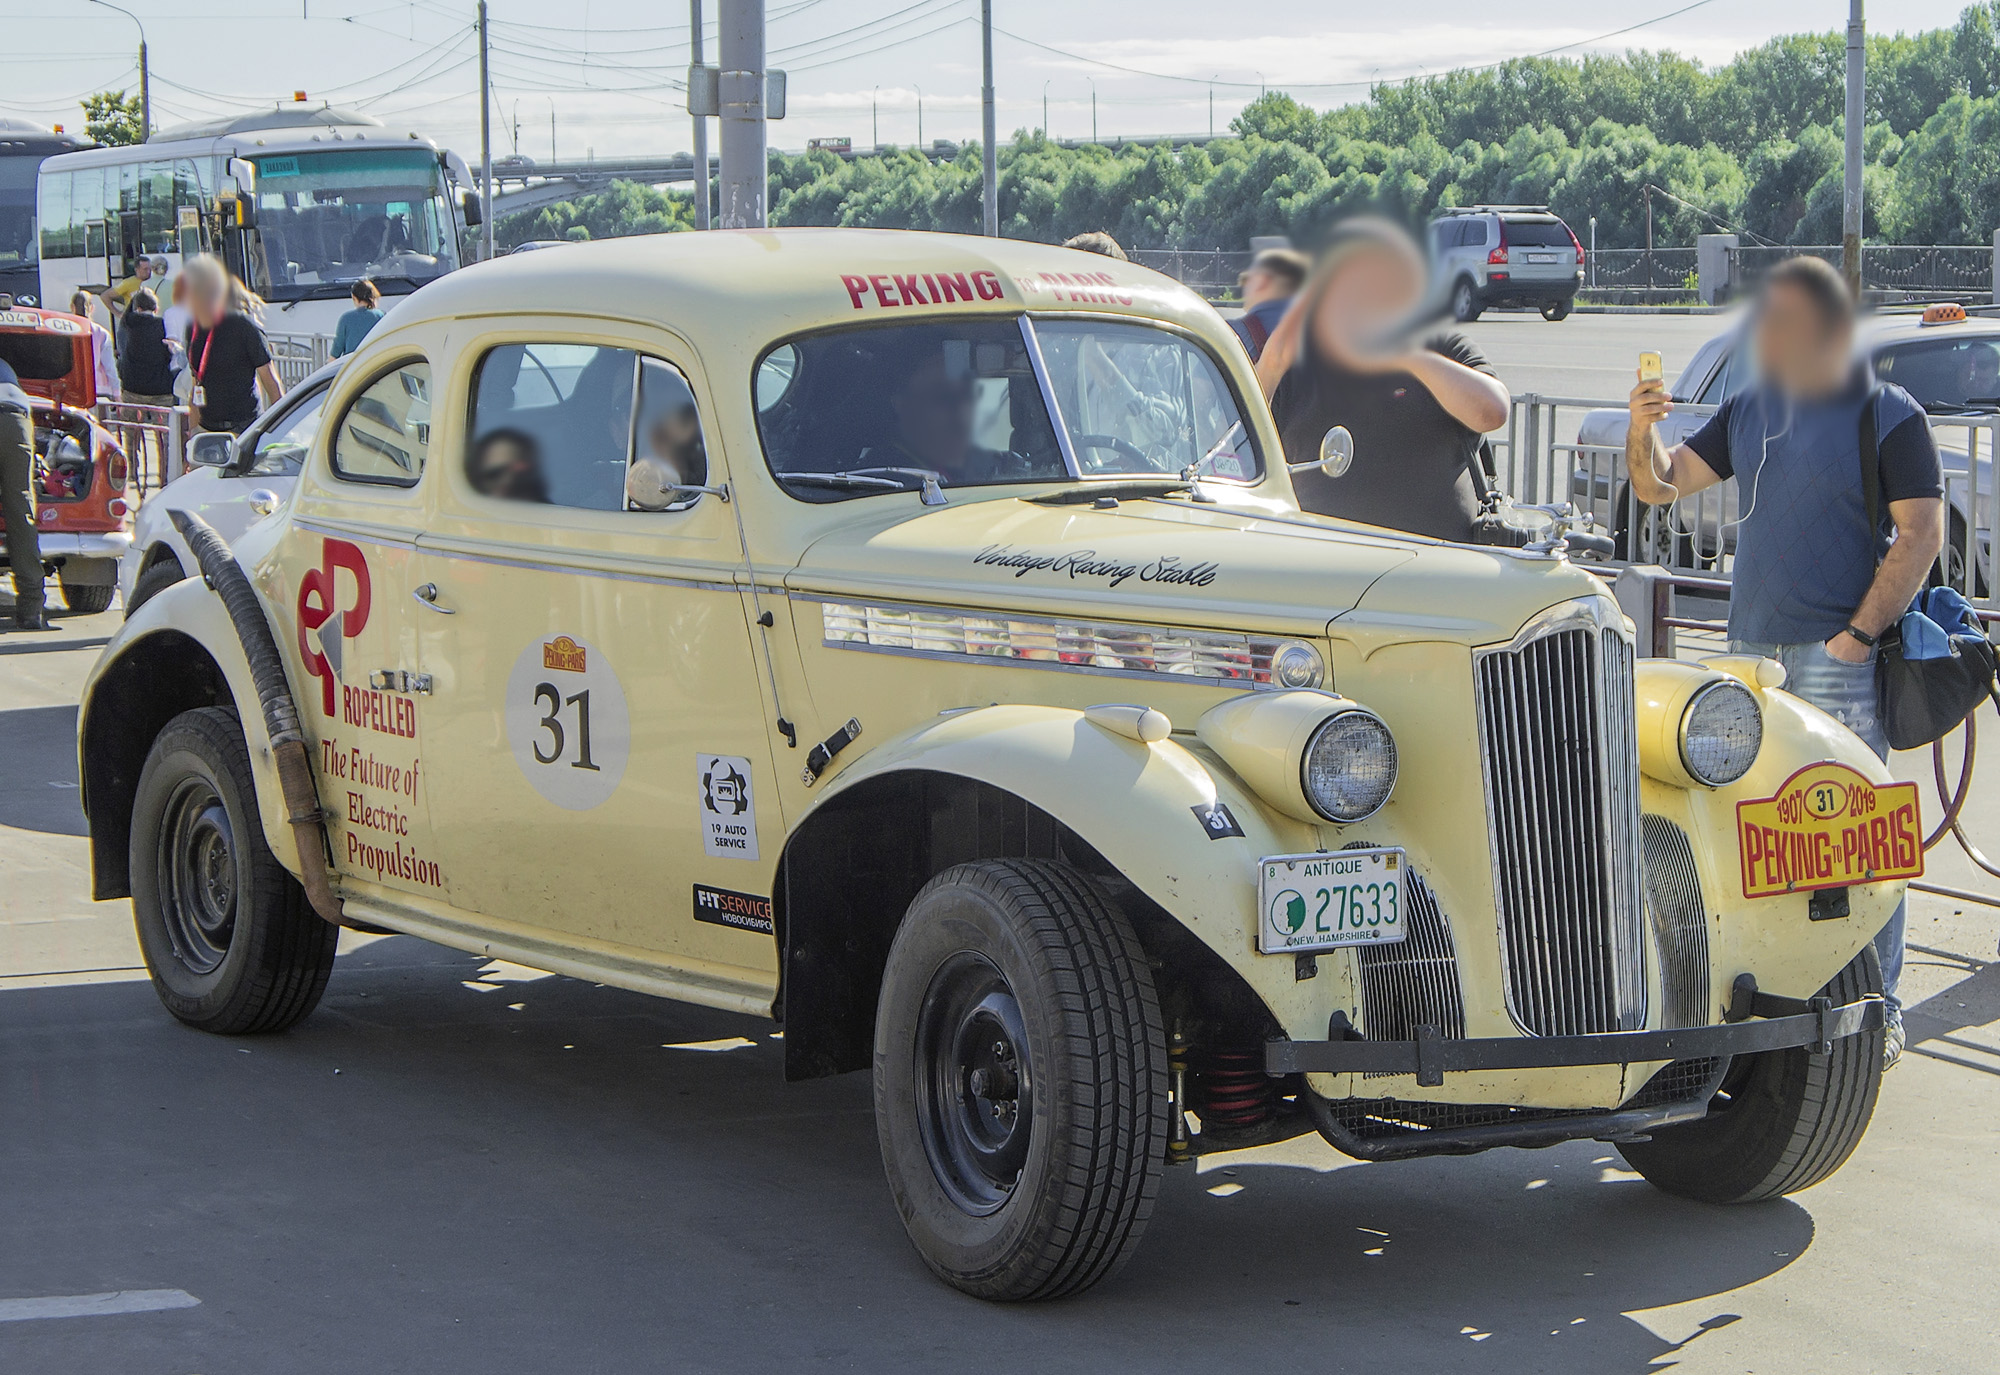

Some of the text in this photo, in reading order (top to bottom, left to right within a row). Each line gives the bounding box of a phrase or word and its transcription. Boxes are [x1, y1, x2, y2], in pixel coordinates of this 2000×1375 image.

[839, 270, 1133, 309] PEKING TO PARIS
[53, 320, 73, 331] CH
[973, 543, 1220, 588] Vintage Racing Stable
[533, 682, 600, 771] 31
[322, 738, 419, 806] The Future of
[347, 791, 408, 836] Electric
[1205, 810, 1232, 830] 31
[1777, 783, 1876, 824] 1907 31 2019
[711, 823, 747, 836] 19 AUTO
[715, 836, 746, 849] SERVICE
[1745, 803, 1916, 887] PEKING TO PARIS
[347, 831, 441, 887] Propulsion
[1269, 866, 1276, 878] 8
[1304, 860, 1362, 877] ANTIQUE
[1316, 881, 1397, 932] 27633
[1294, 930, 1372, 945] NEW HAMPSHIRE
